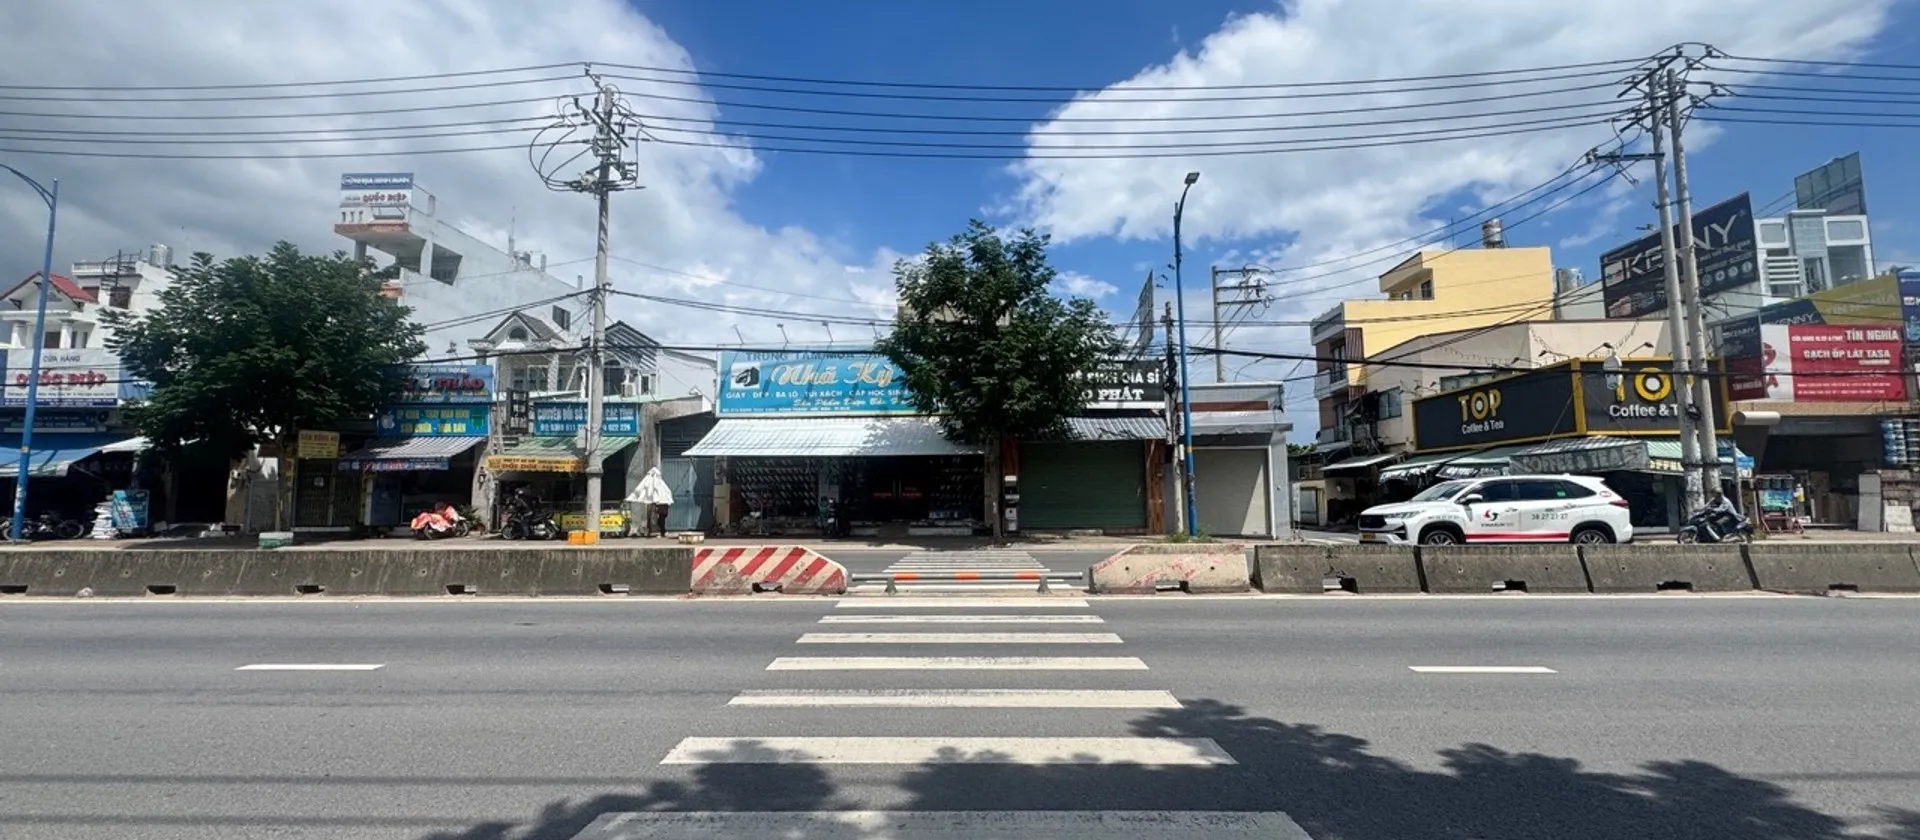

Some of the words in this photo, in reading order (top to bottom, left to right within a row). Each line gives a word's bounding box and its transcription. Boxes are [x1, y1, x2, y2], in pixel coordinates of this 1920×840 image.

[1625, 214, 1737, 279] KENY
[1458, 388, 1501, 422] TOP
[1609, 404, 1657, 417] Coffee
[1461, 424, 1483, 434] Coffee
[1490, 419, 1504, 430] Tea
